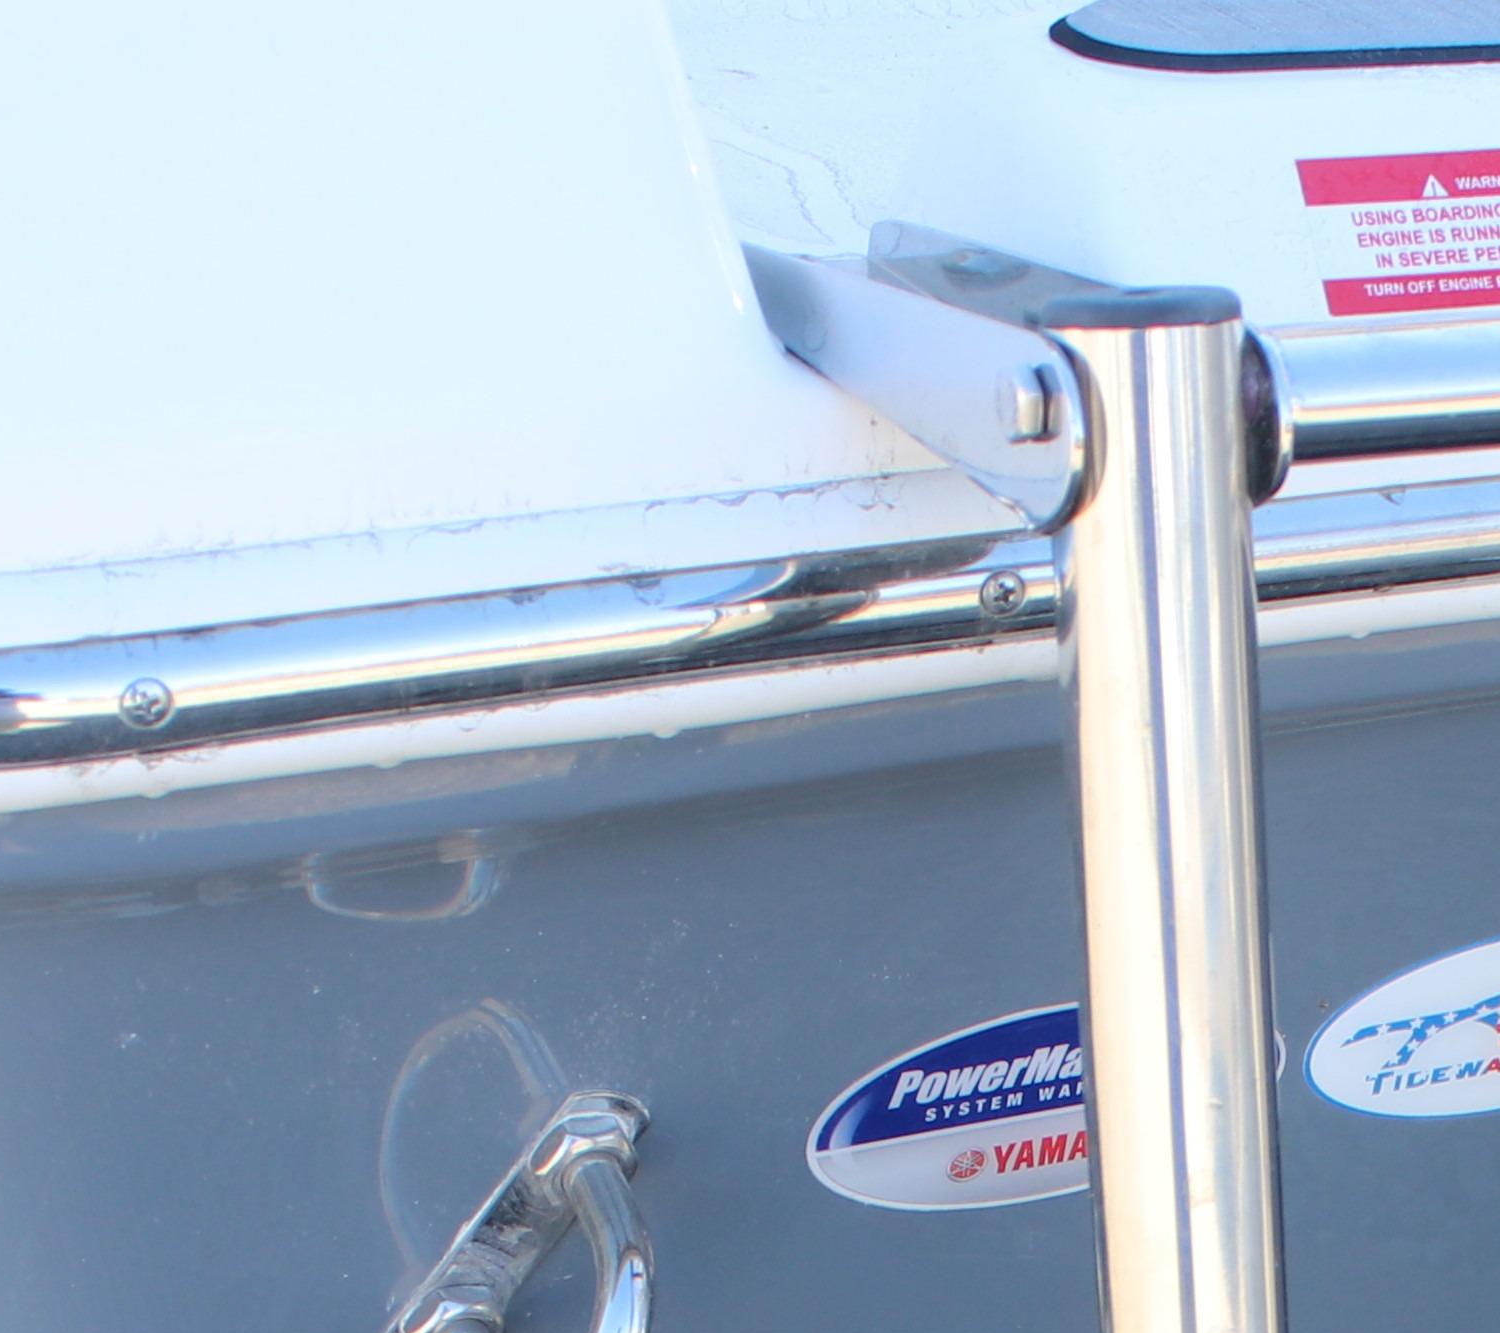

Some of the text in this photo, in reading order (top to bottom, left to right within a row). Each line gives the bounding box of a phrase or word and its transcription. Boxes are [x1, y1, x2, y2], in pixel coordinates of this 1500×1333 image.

[1351, 208, 1406, 227] USING
[1357, 228, 1424, 248] ENGINE
[1430, 228, 1445, 243] IS
[1375, 252, 1393, 269] IN
[1399, 247, 1470, 267] SEVERE
[1364, 281, 1405, 297] TURN
[1408, 280, 1436, 294] OFF
[1439, 276, 1494, 293] ENGINE
[888, 1043, 1083, 1111] PowerMa
[925, 1091, 1023, 1123] SYSTEM
[994, 1130, 1089, 1175] YAMA
